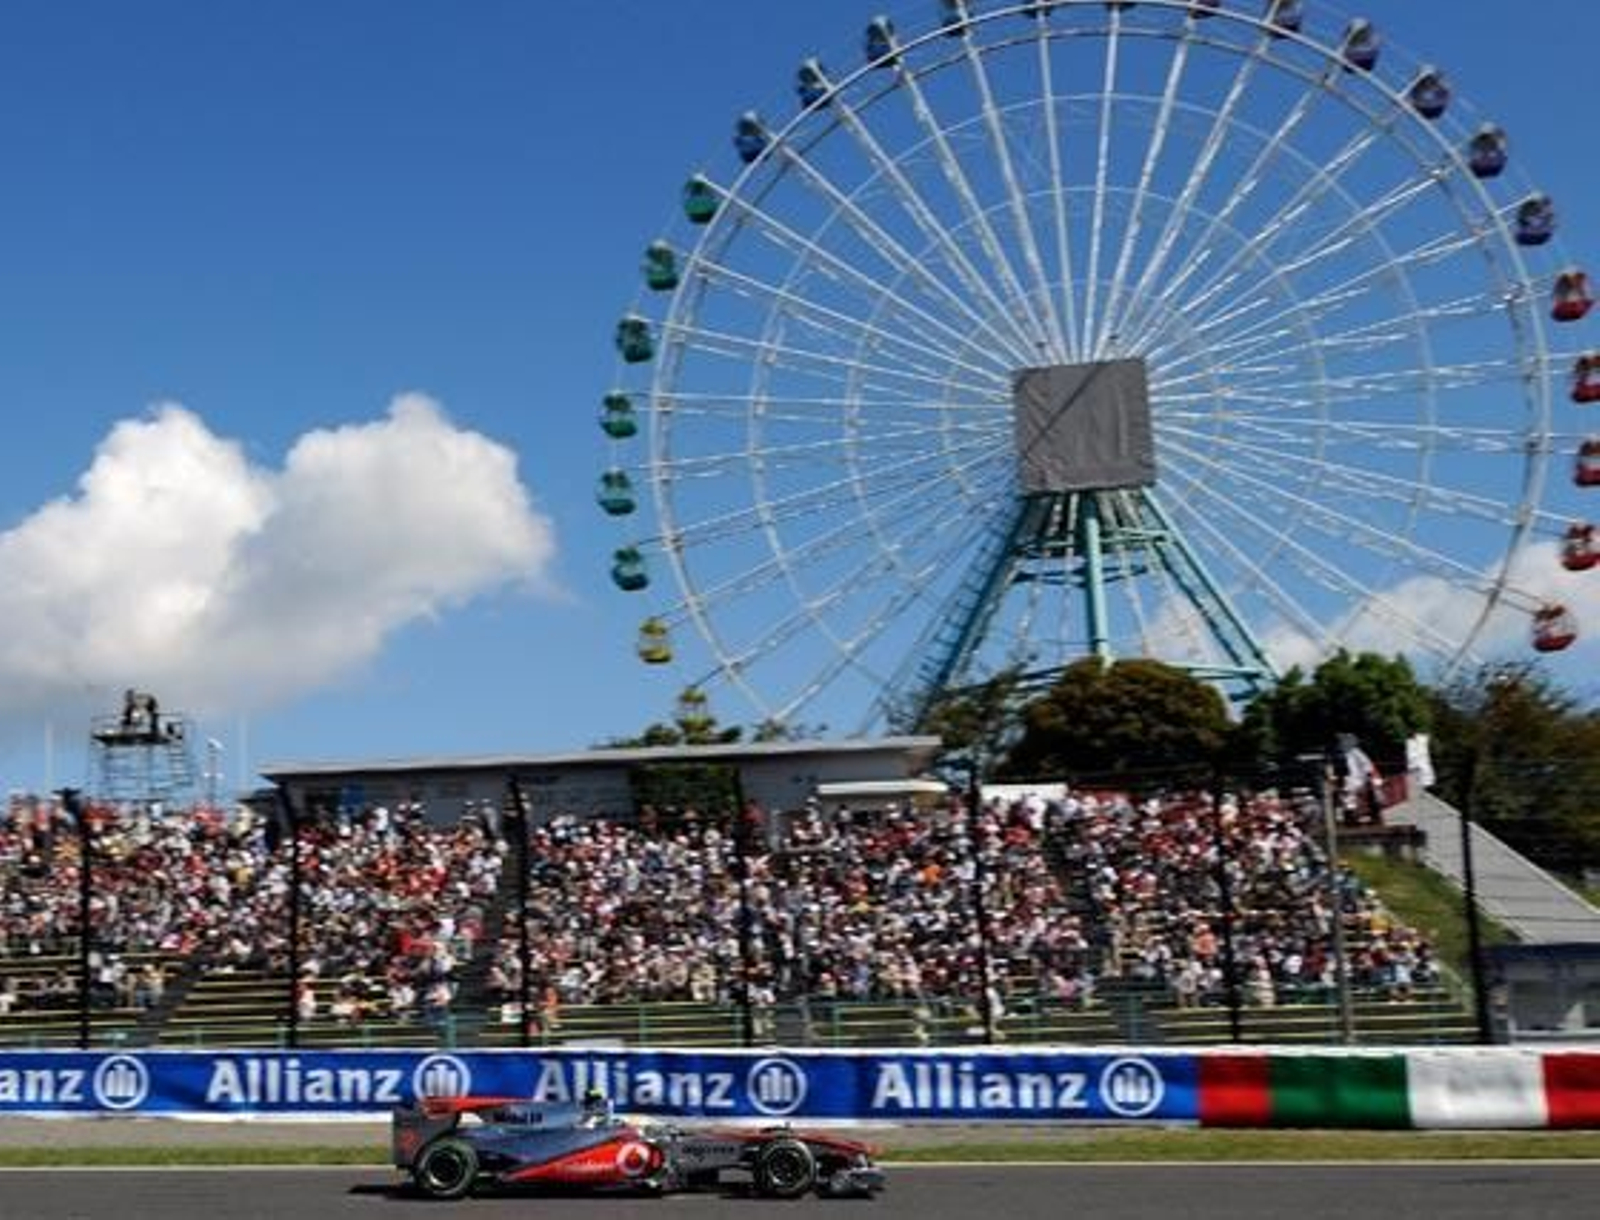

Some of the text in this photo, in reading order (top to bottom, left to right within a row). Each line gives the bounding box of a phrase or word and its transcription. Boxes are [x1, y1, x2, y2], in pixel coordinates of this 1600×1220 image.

[206, 1059, 401, 1102] Allianz
[533, 1060, 735, 1107] Allianz
[871, 1061, 1088, 1108] Allianz
